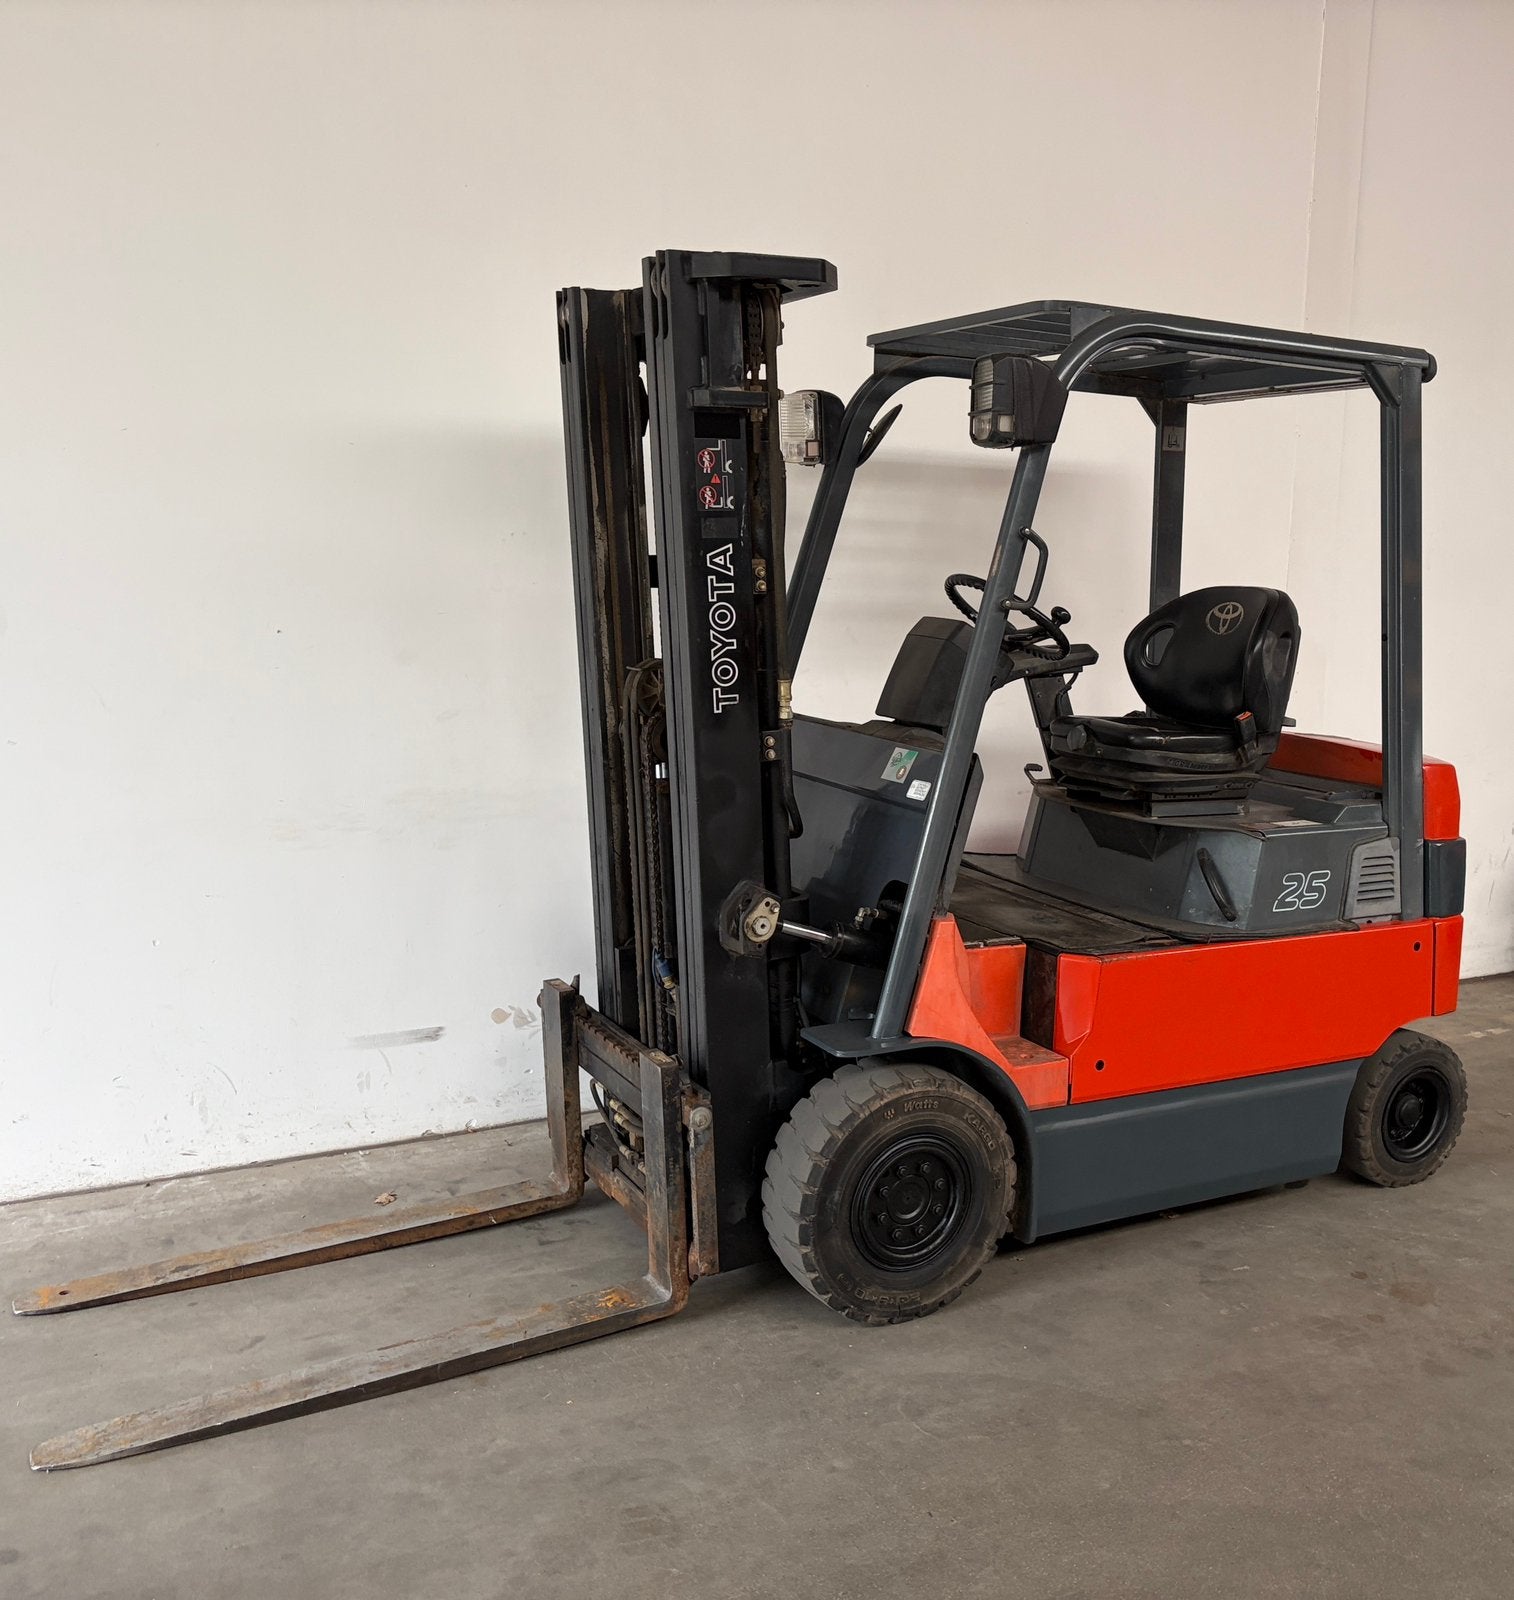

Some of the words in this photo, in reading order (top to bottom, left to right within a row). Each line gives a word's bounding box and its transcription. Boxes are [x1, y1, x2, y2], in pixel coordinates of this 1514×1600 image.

[706, 543, 740, 714] TOYOTA
[1272, 869, 1331, 912] 25
[903, 1099, 939, 1113] Watts
[963, 1112, 996, 1151] KARGO
